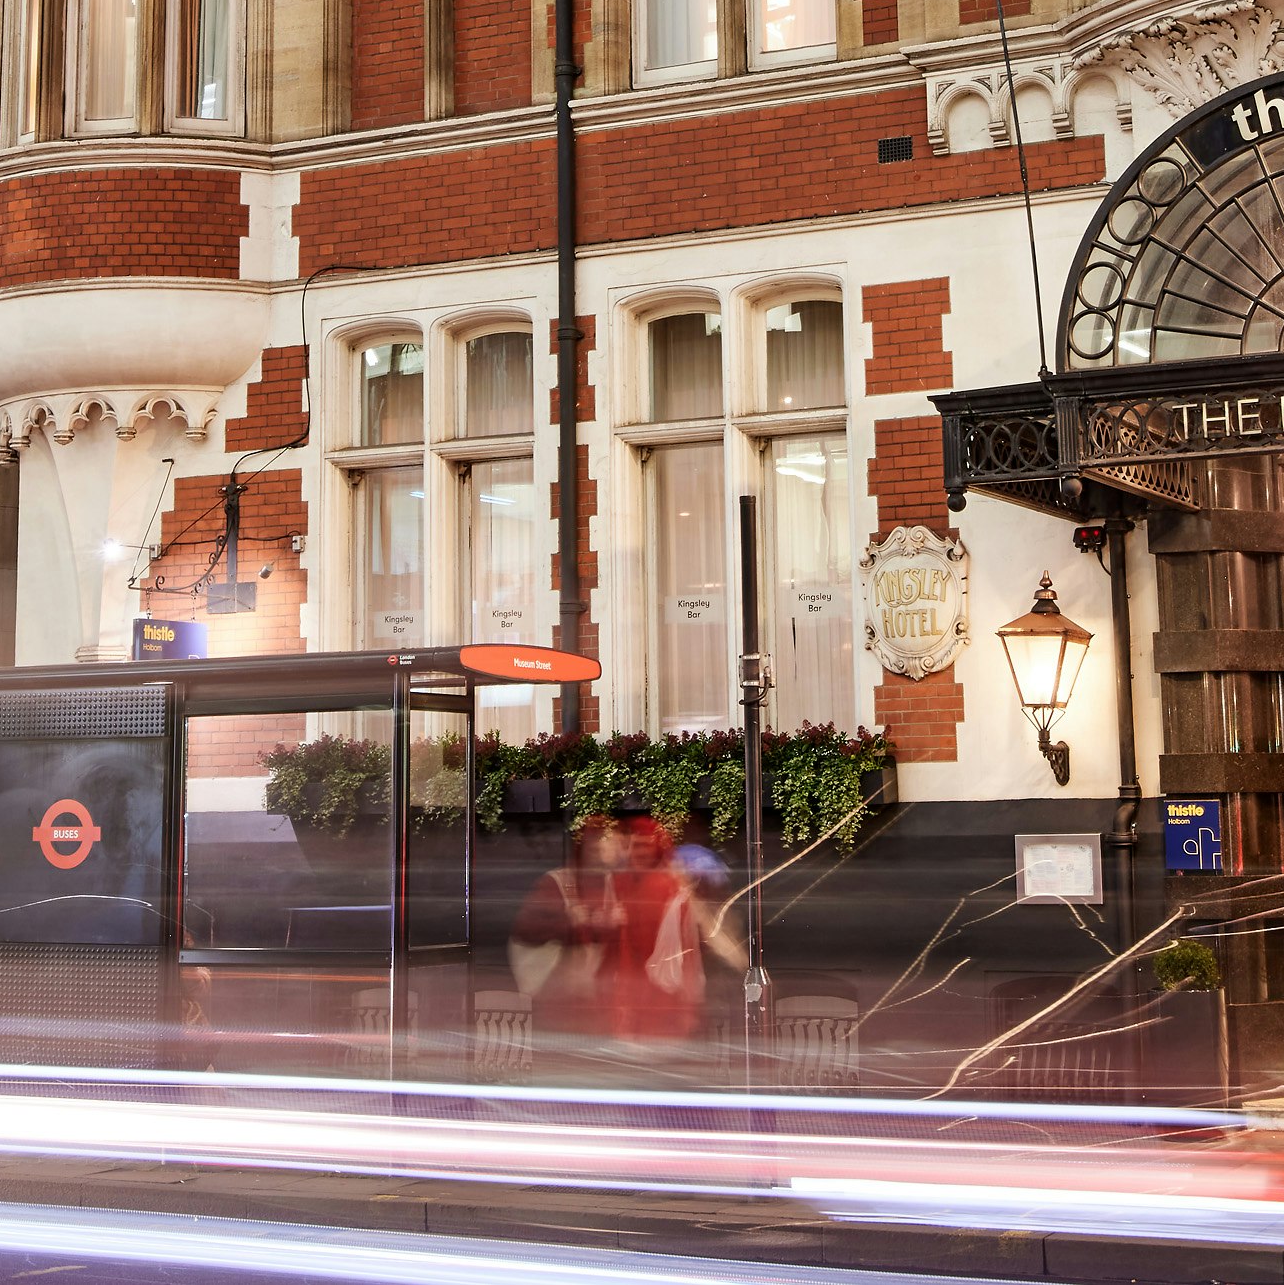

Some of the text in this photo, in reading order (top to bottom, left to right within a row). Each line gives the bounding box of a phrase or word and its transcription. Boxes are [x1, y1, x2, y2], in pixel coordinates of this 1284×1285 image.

[1172, 399, 1262, 440] THE
[874, 568, 951, 608] KINGSLEY
[798, 593, 832, 602] Kingsley
[678, 600, 710, 609] Kingsley
[808, 604, 822, 612] Bar
[492, 610, 522, 619] Kingsley
[687, 611, 701, 619] Bar
[384, 615, 414, 624] Kingsley
[882, 608, 945, 638] HOTEL
[143, 624, 175, 642] thistle
[142, 643, 163, 652] Holborn
[513, 658, 552, 670] Museum Street
[1167, 804, 1204, 816] thistle
[53, 830, 79, 839] BUSES
